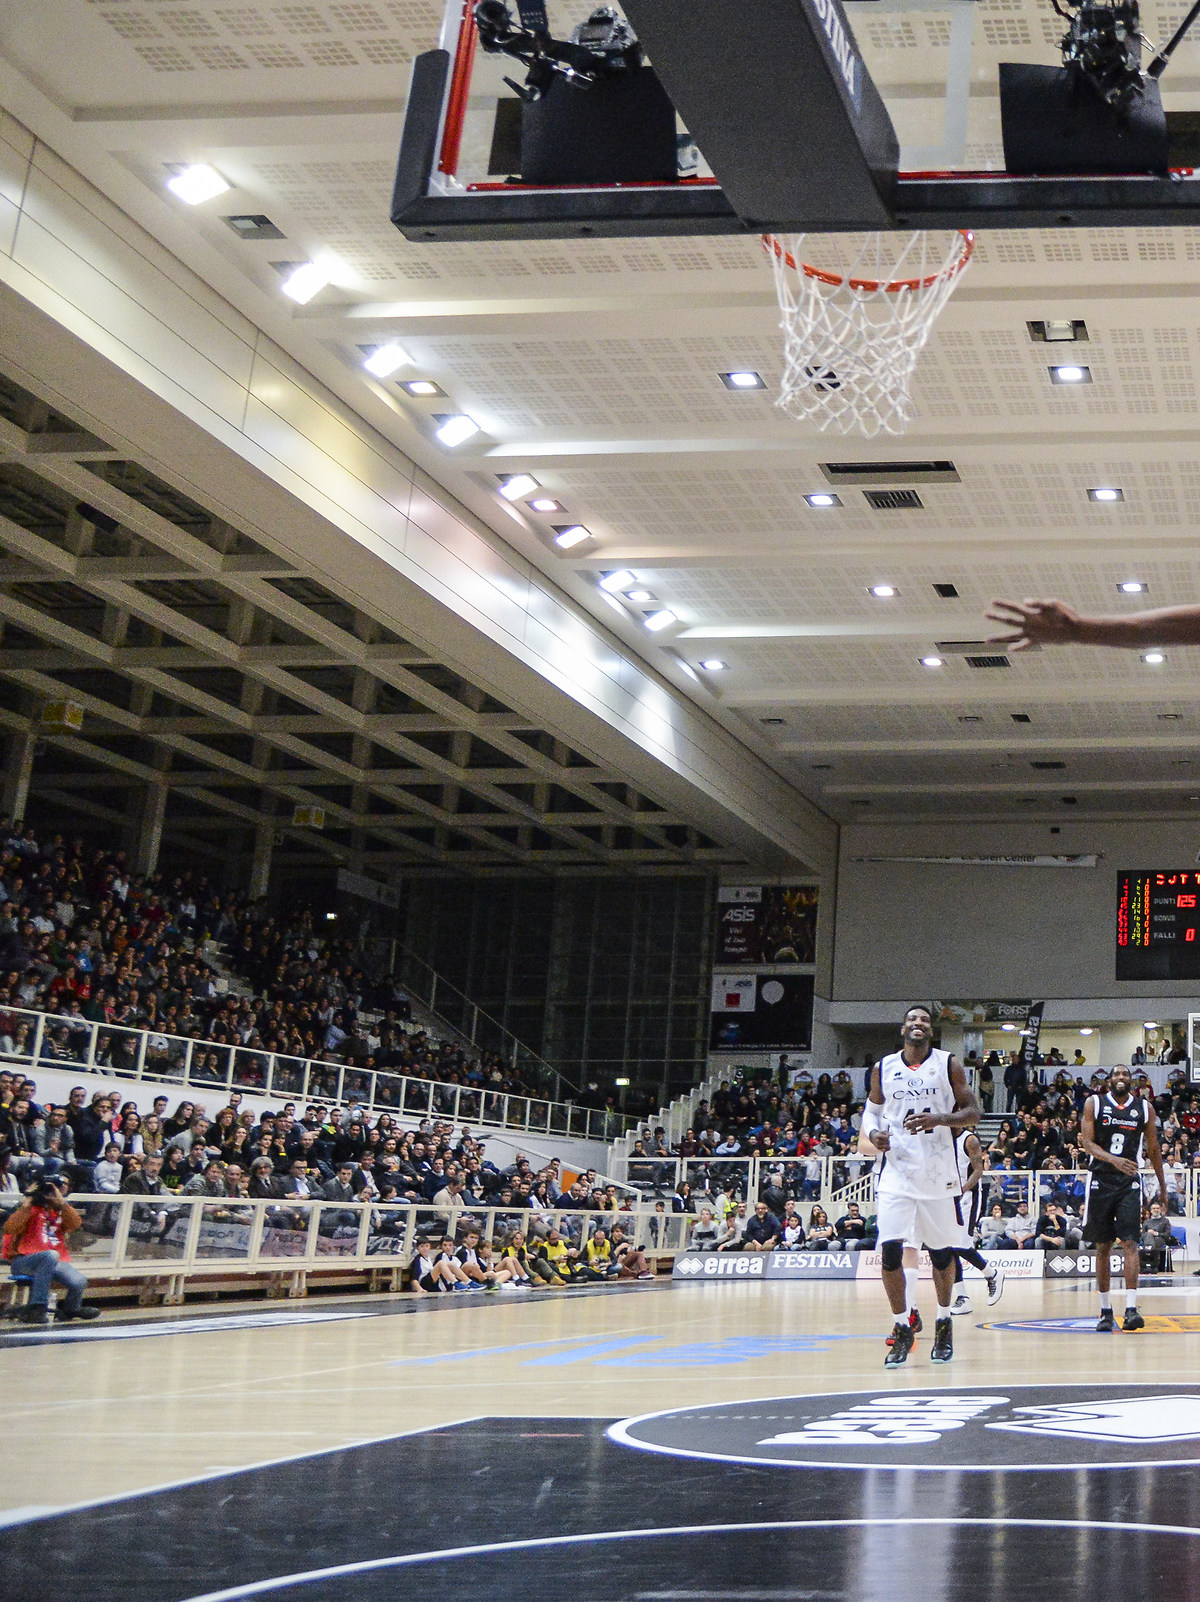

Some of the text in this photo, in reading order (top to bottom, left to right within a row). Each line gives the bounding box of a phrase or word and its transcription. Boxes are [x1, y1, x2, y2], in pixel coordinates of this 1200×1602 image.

[1176, 894, 1197, 908] 125
[1153, 928, 1196, 942] FALLI 0
[998, 1005, 1031, 1015] FORST
[892, 1088, 940, 1100] CAVIT
[1110, 1132, 1125, 1155] 8
[704, 1257, 763, 1275] errea
[772, 1253, 853, 1269] FESTINA
[984, 1258, 1034, 1268] olomiti
[1002, 1268, 1033, 1277] nergia
